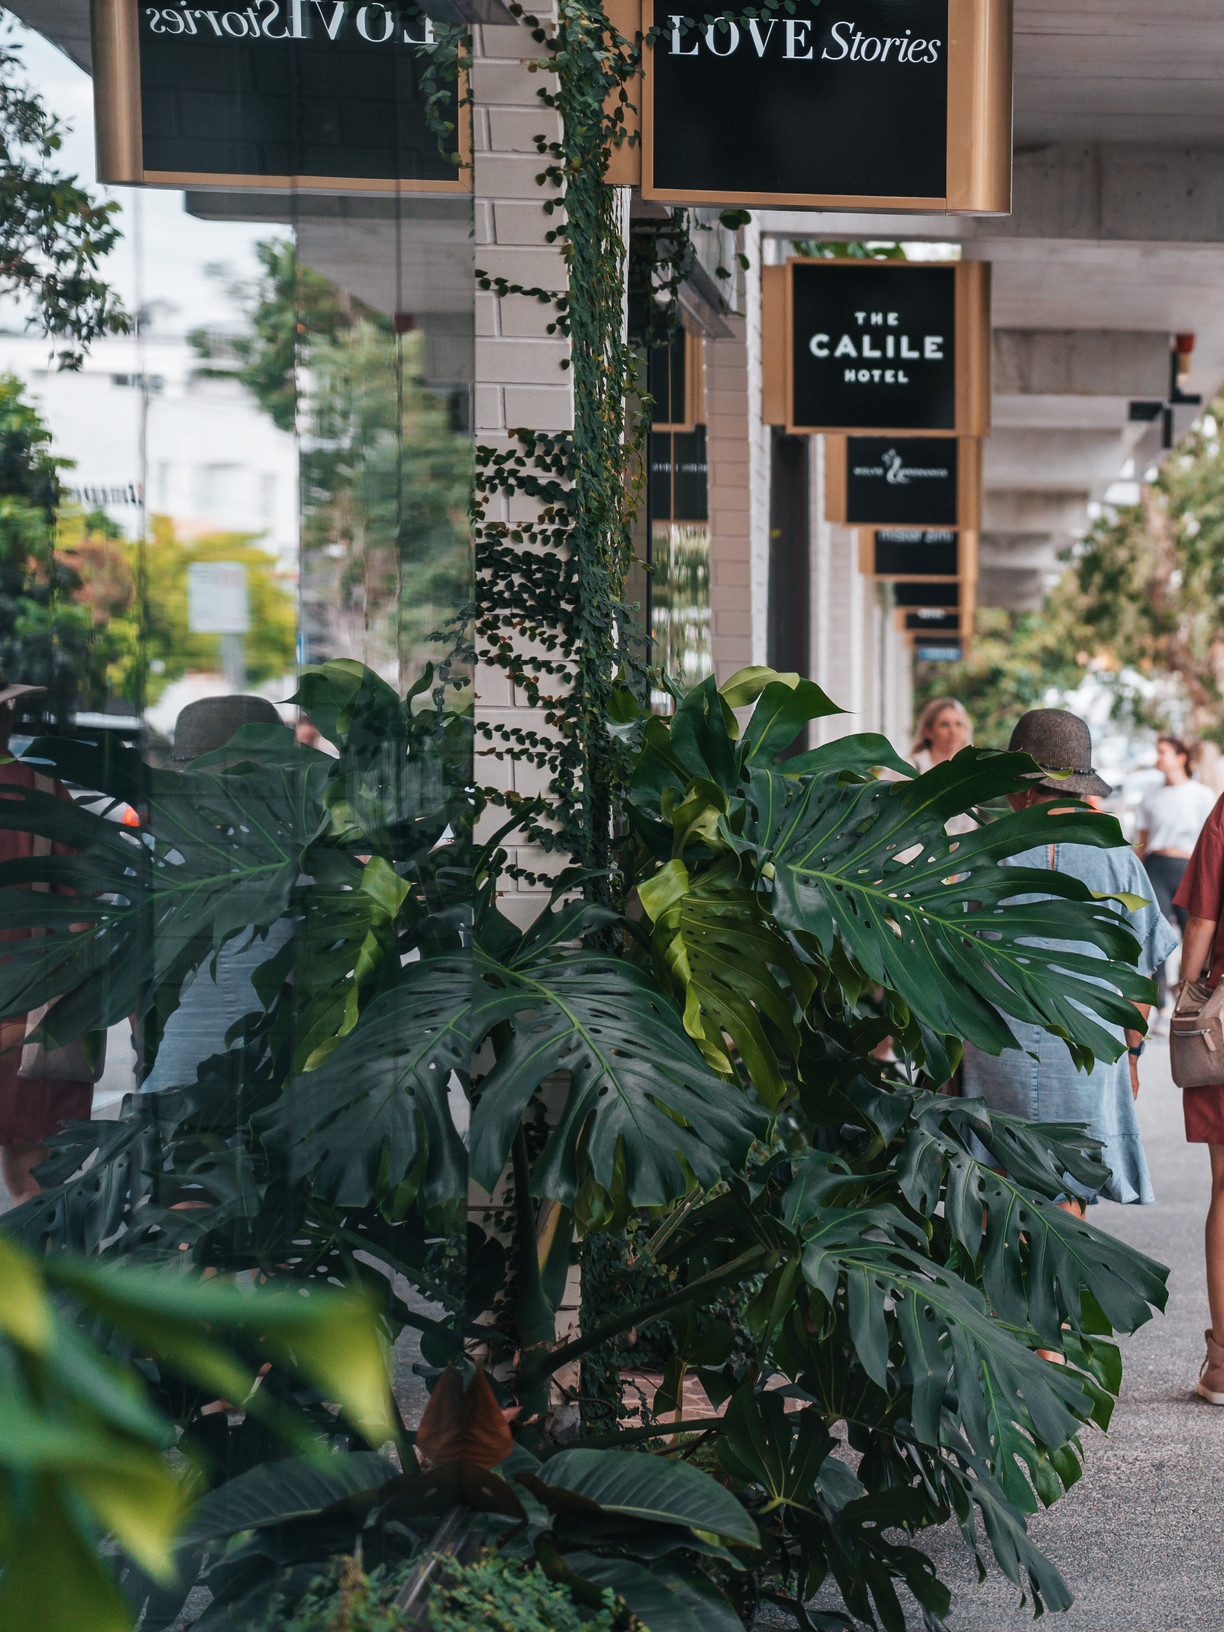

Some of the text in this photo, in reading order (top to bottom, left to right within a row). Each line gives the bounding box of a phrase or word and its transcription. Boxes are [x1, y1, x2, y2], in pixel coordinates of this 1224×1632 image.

[667, 14, 942, 63] LOVE Stories
[854, 310, 900, 326] THE
[808, 333, 945, 360] CALILE
[844, 368, 910, 384] HOTEL
